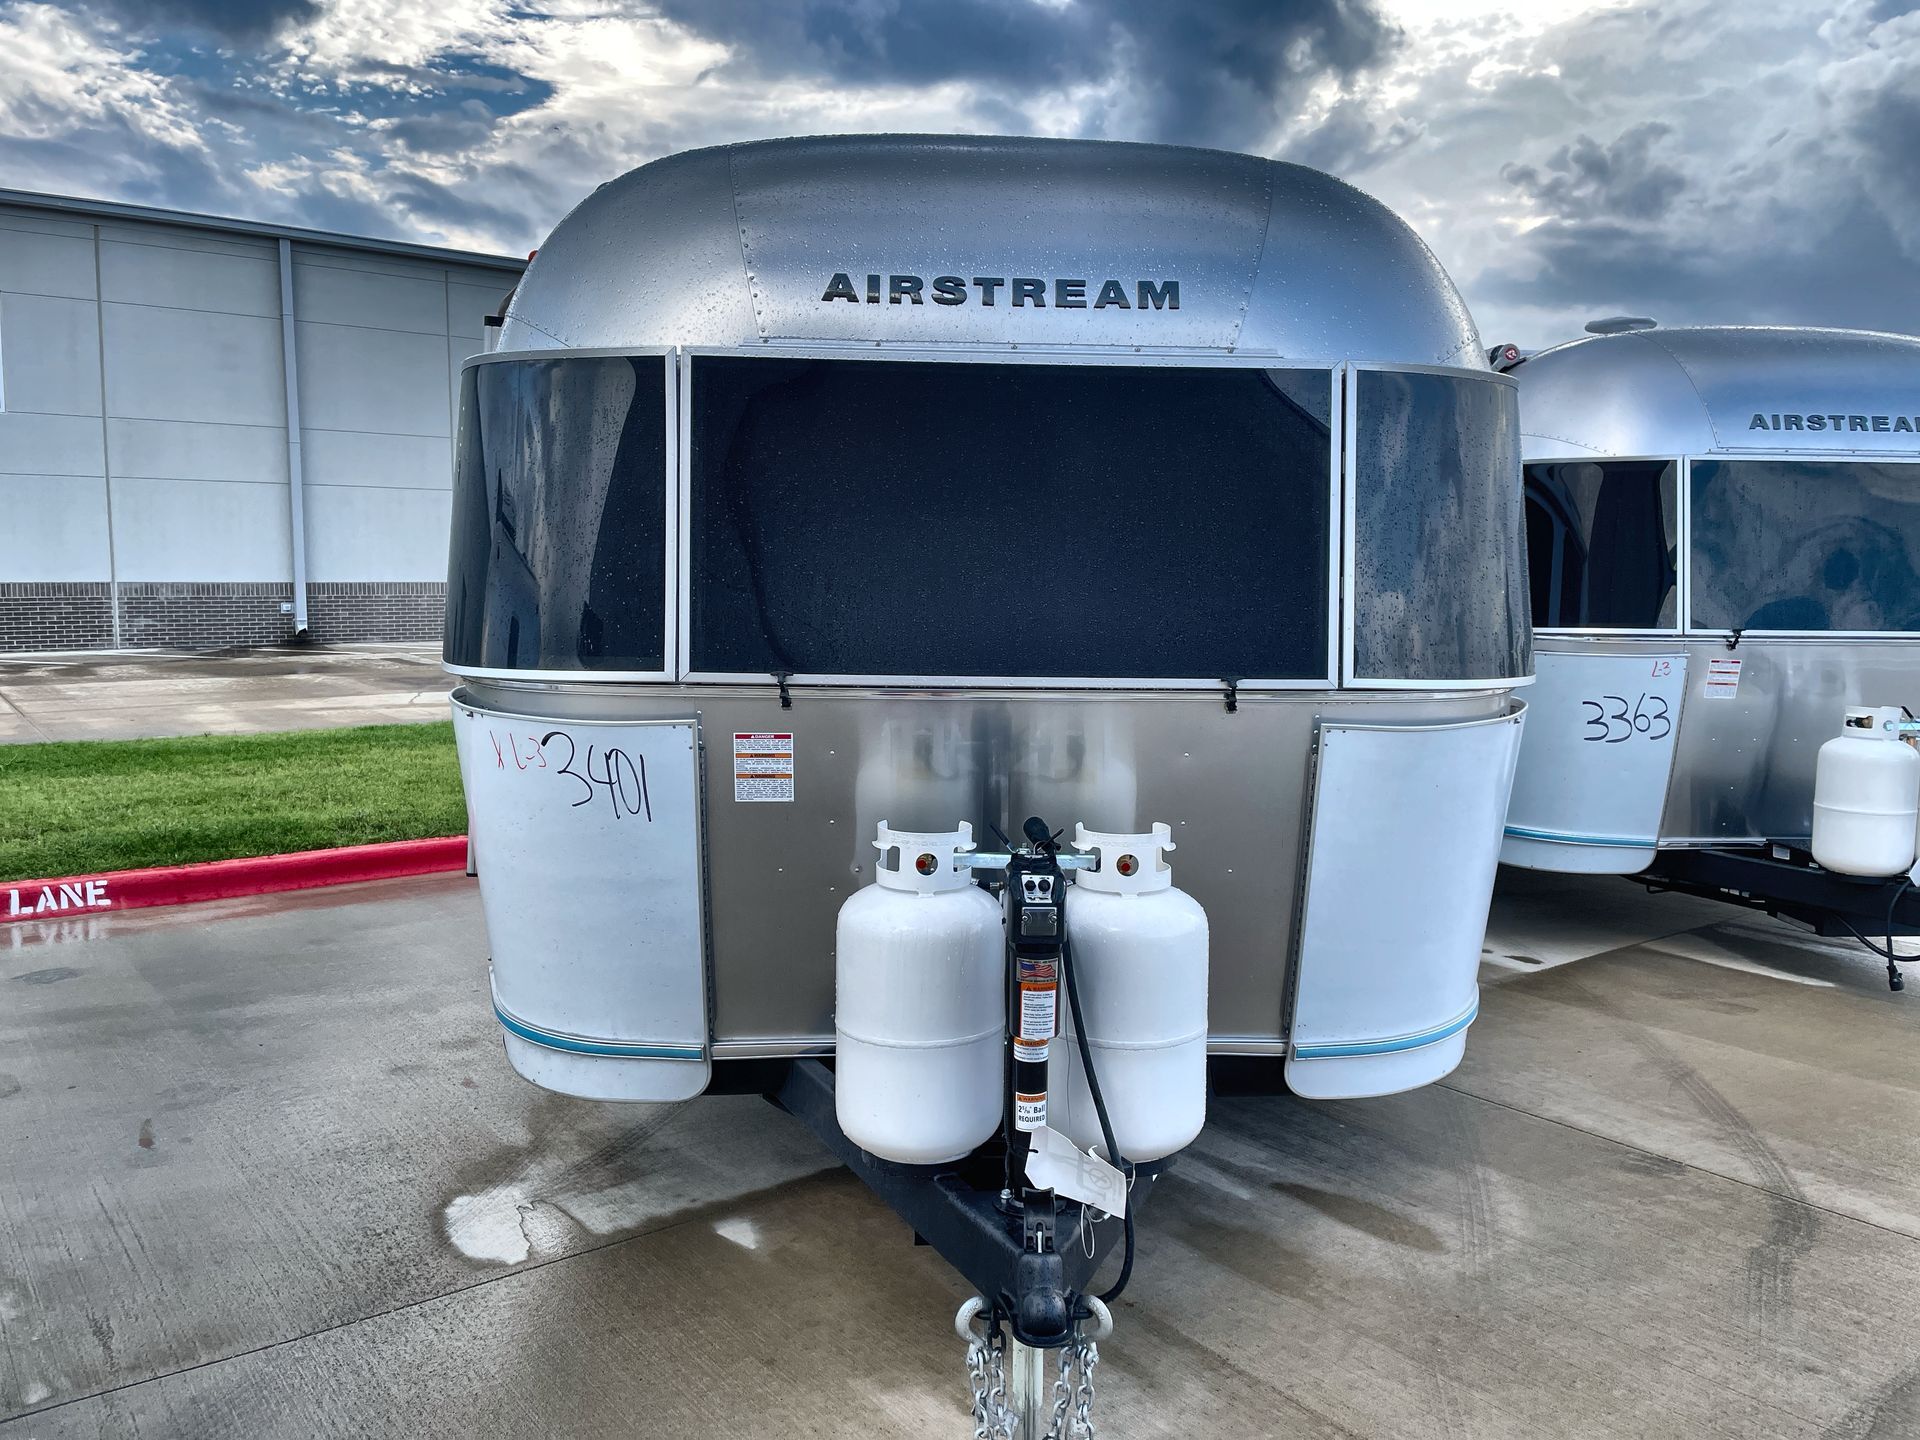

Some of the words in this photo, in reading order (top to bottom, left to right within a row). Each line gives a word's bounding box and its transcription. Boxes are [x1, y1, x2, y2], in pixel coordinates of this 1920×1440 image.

[821, 272, 1180, 310] AIRSTREAM
[1749, 413, 1920, 433] AIRSTREA
[1582, 692, 1671, 744] 3363
[541, 731, 652, 823] 3401
[9, 880, 112, 916] LANE
[1018, 1114, 1046, 1123] REQUIRED
[1033, 1104, 1046, 1114] Ball
